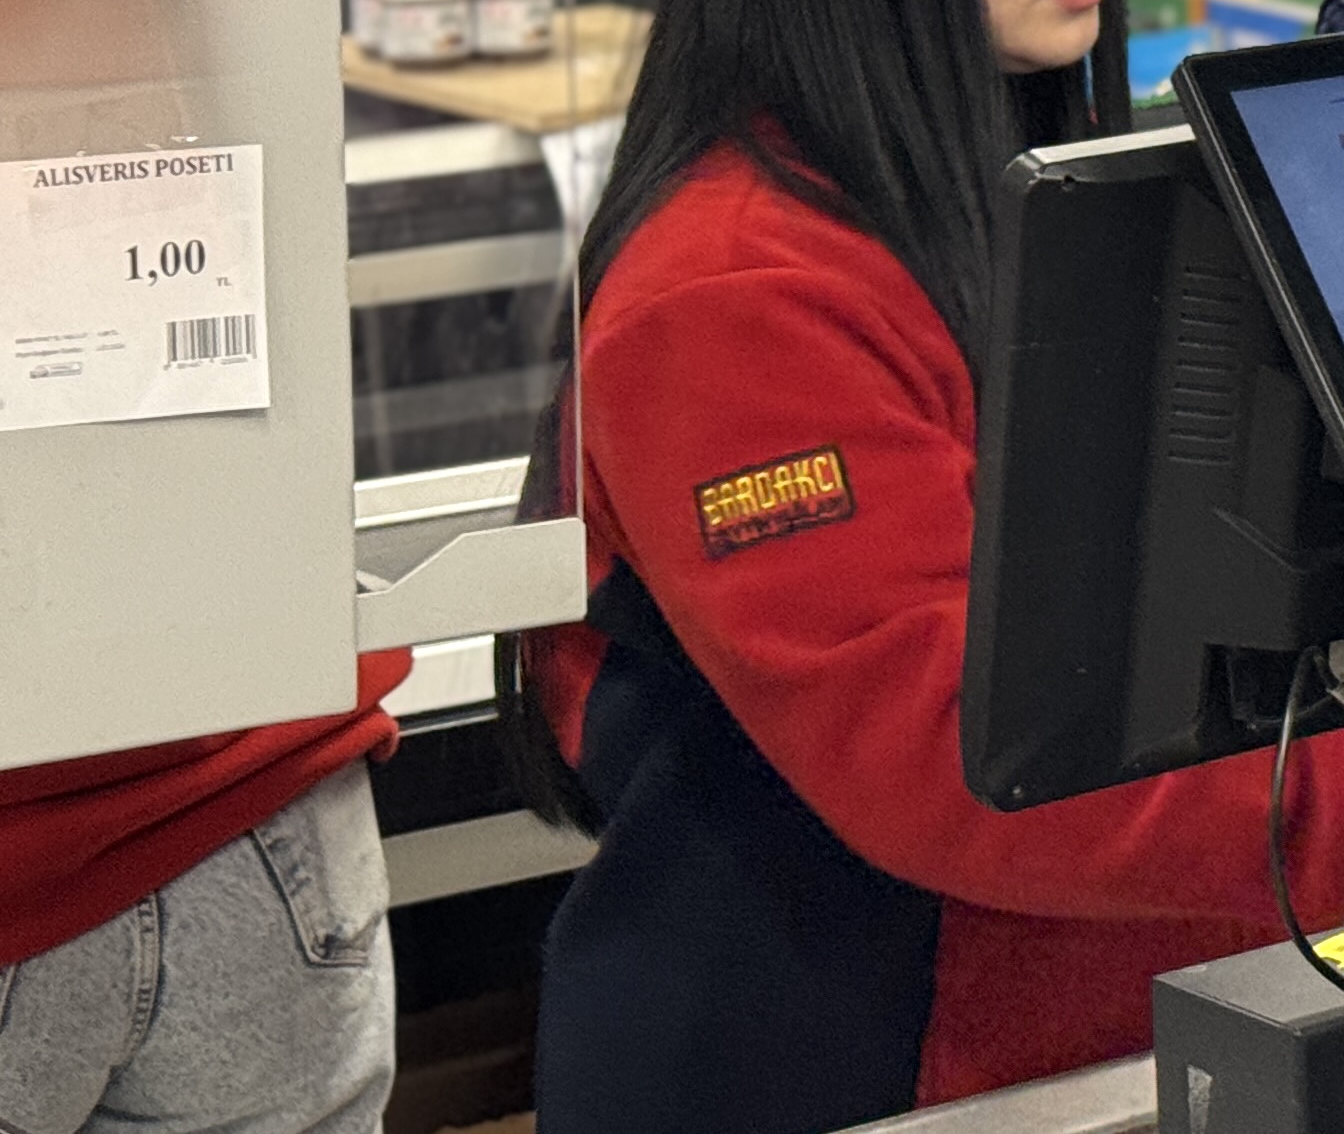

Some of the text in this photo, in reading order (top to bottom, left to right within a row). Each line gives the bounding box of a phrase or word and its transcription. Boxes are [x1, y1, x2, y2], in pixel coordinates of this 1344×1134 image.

[33, 153, 234, 188] ALISVERIS POSETI
[124, 239, 206, 287] 1,00
